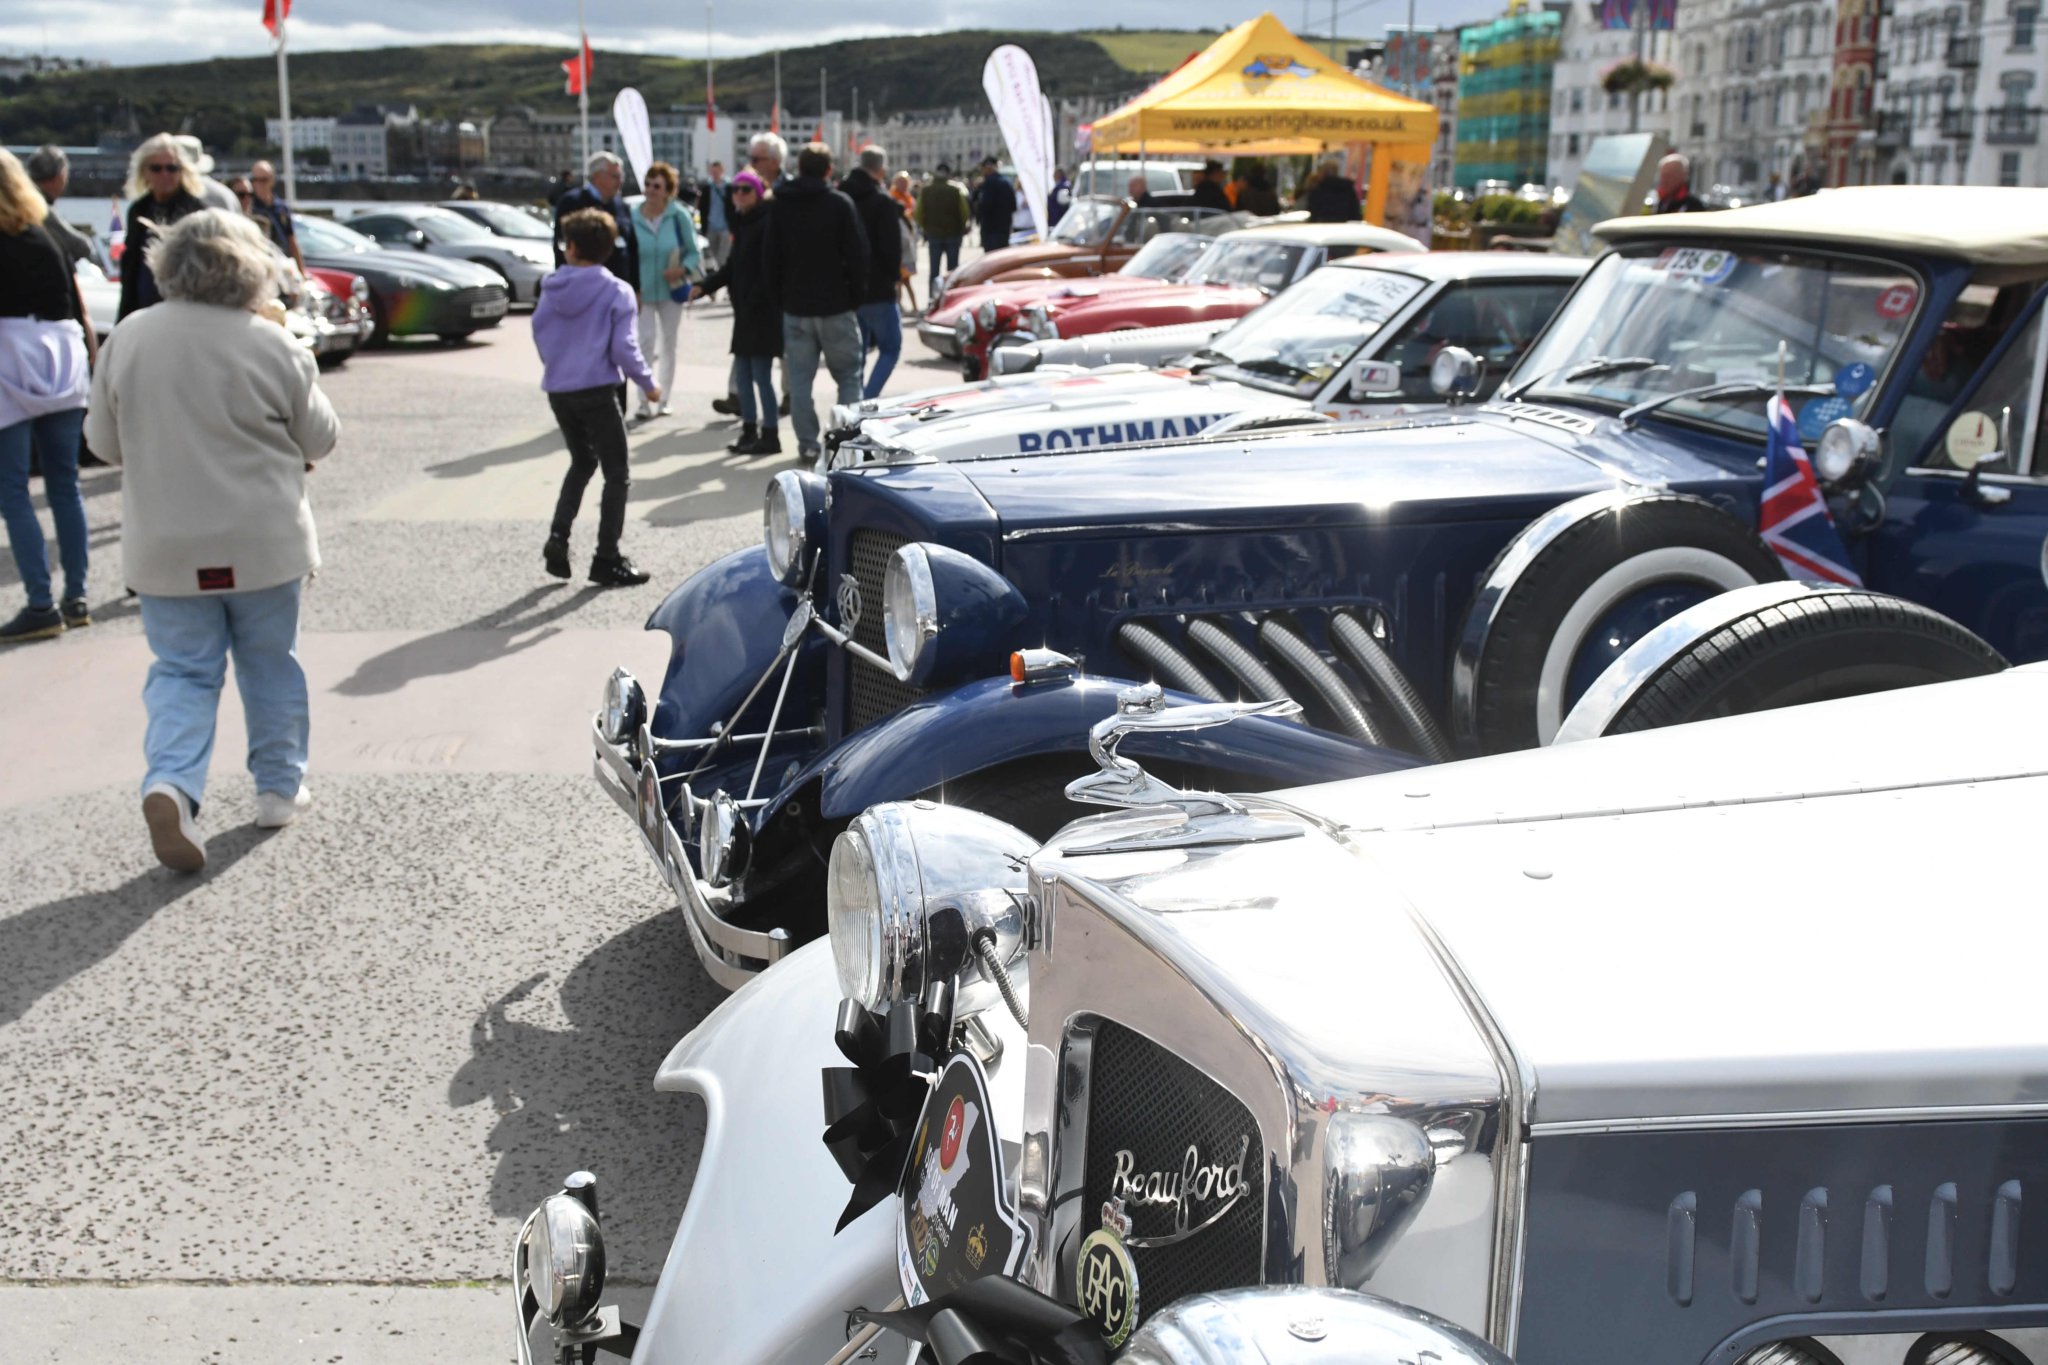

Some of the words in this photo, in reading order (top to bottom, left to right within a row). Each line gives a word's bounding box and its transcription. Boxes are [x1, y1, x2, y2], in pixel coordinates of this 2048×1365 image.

[1172, 113, 1407, 132] www.sportingbears.co.uk
[931, 1167, 942, 1196] OF
[1112, 1135, 1250, 1240] Beauford
[936, 1184, 959, 1232] MAN
[1085, 1252, 1124, 1332] RAC
